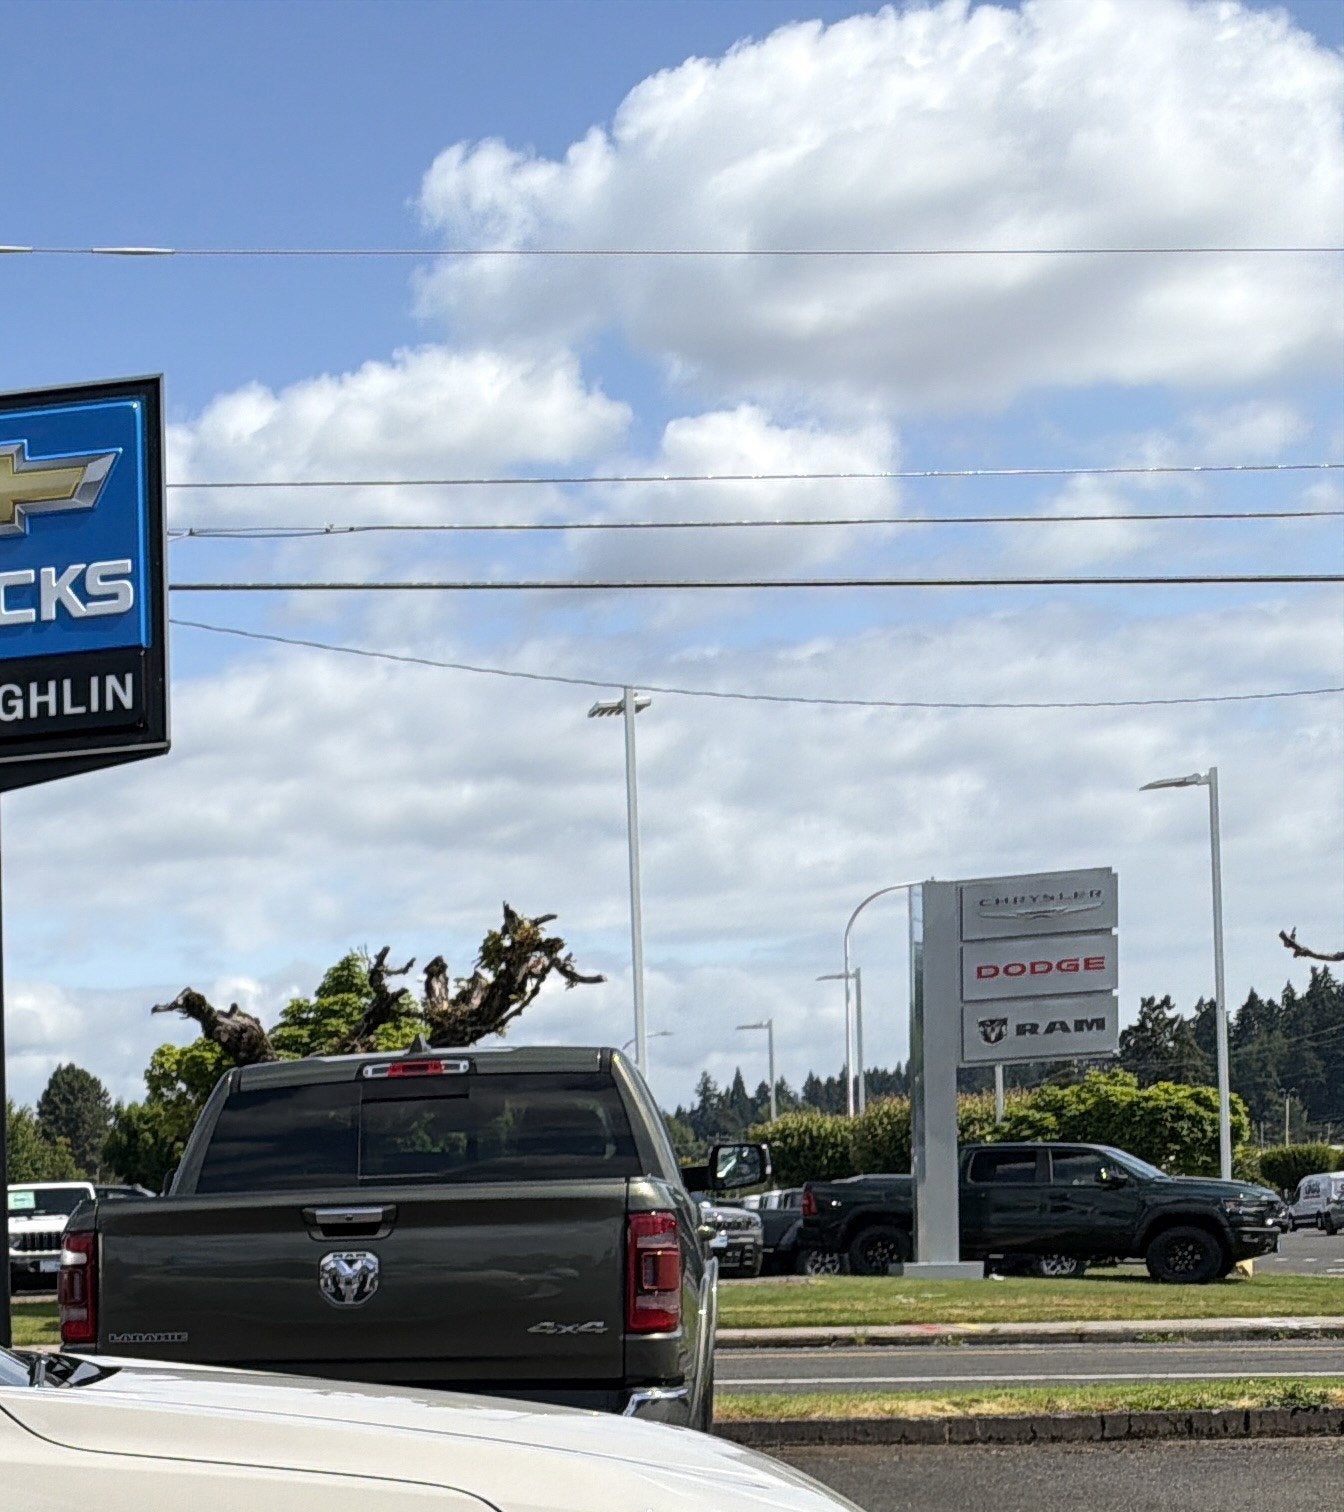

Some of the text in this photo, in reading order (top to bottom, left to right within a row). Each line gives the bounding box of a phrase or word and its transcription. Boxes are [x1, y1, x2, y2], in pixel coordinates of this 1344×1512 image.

[979, 889, 1102, 907] CHRYSLER
[976, 956, 1106, 980] DODGE
[1015, 1017, 1106, 1037] RAM
[526, 1321, 609, 1334] 4x4
